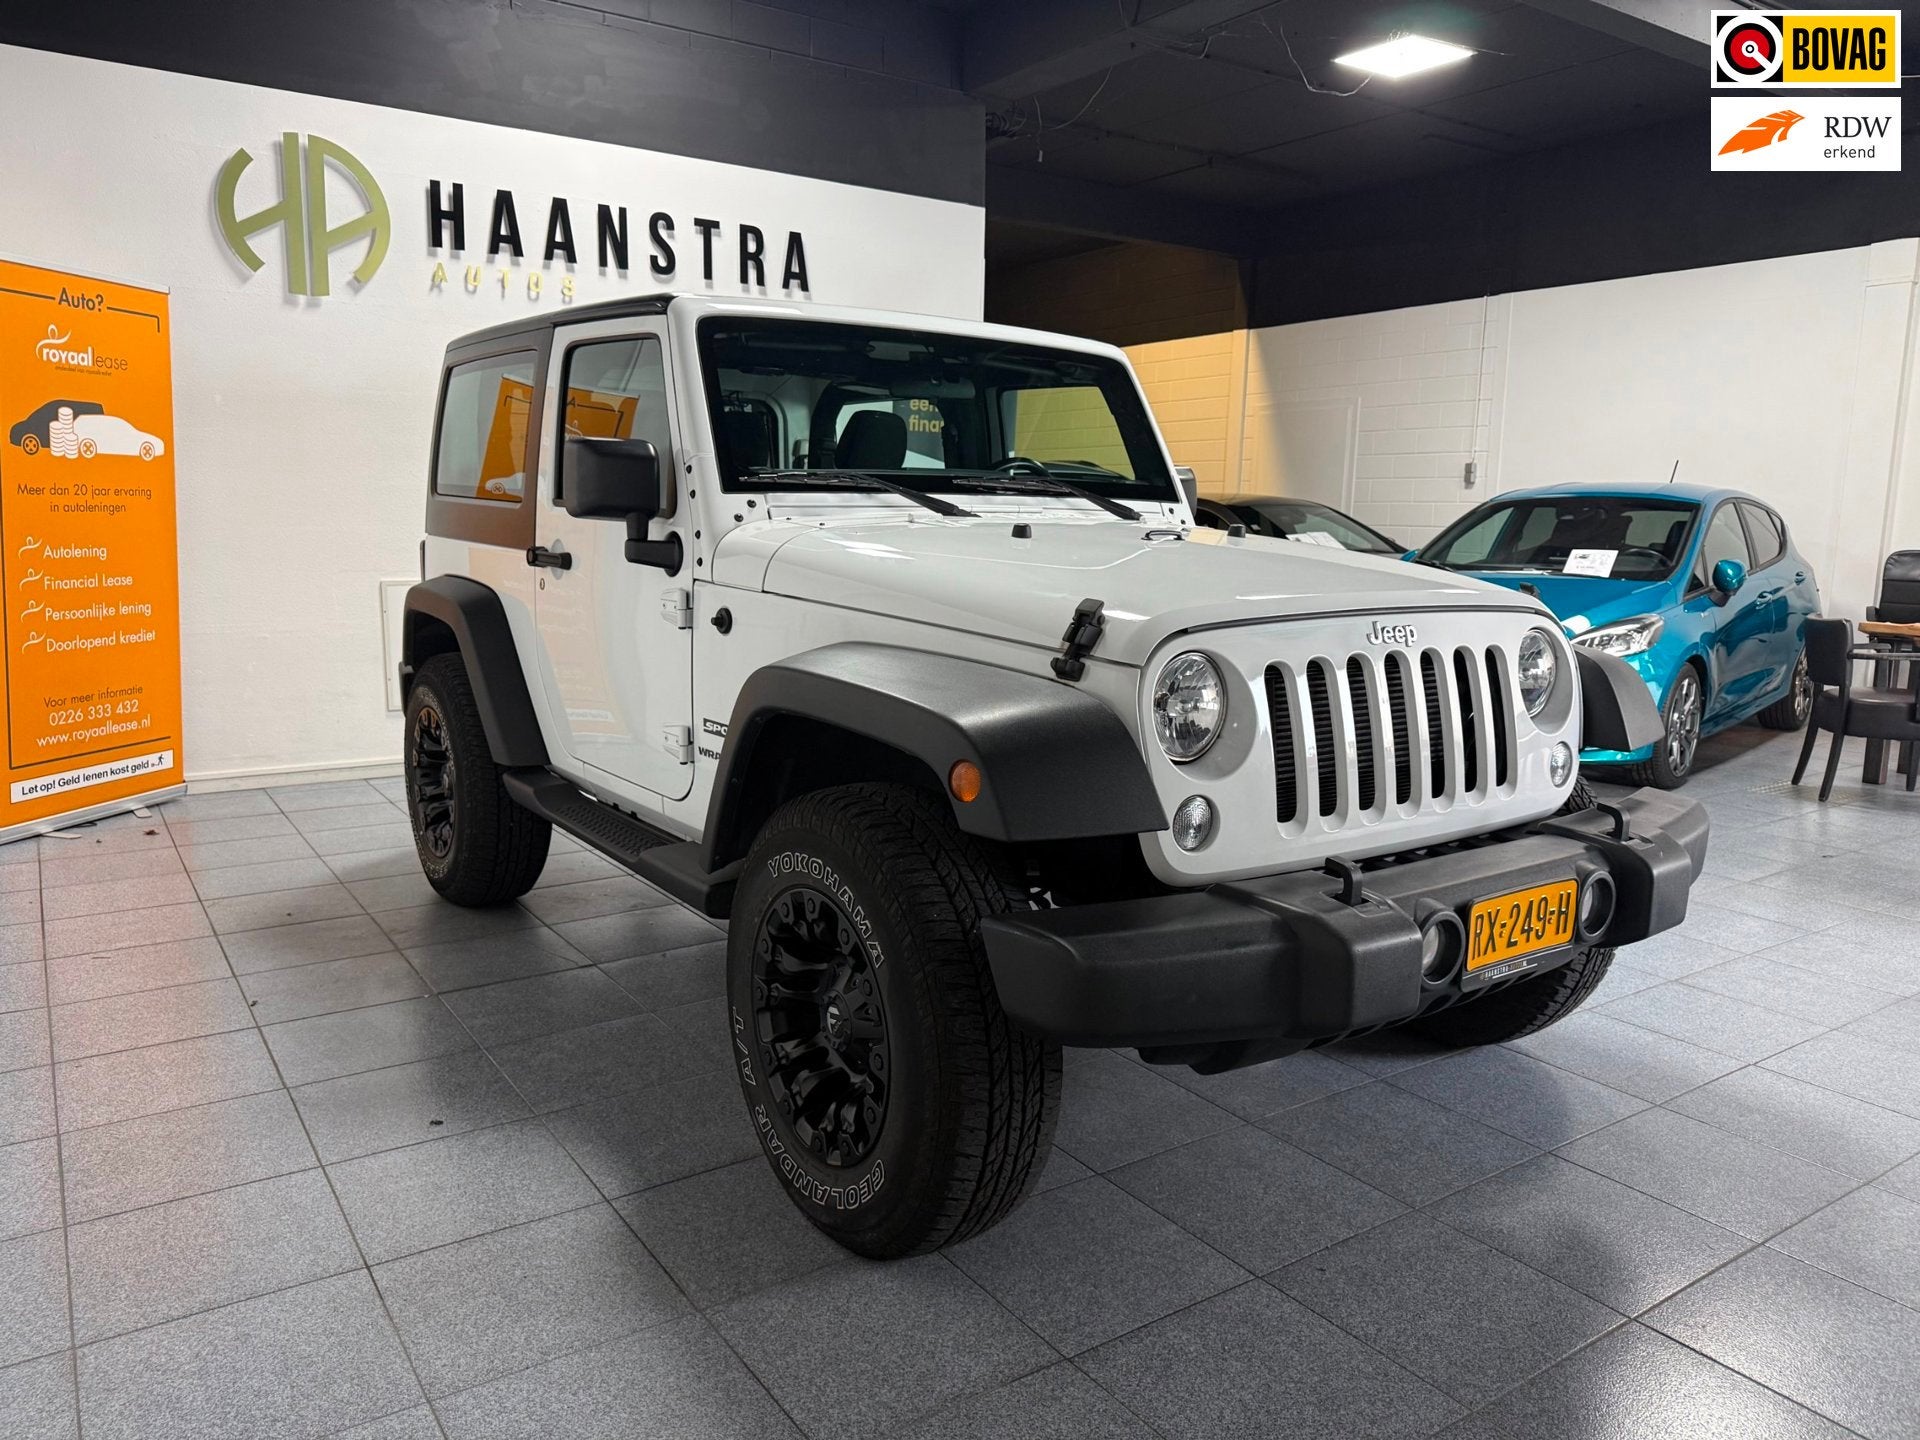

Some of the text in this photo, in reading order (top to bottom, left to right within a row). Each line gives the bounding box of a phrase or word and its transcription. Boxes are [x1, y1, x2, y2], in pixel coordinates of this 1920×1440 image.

[429, 179, 810, 293] HAANSTRA
[432, 262, 577, 297] AUTOS
[58, 287, 104, 312] Auto?
[17, 483, 152, 500] Meer dan 20 jaar ervaring
[50, 500, 127, 516] in autoleningen
[43, 544, 107, 561] Autolening
[44, 573, 133, 590] Financial Lease
[45, 601, 152, 622] Persoonlijke lening
[46, 629, 156, 653] Doorlopend krediet
[1366, 620, 1418, 647] Jeep
[43, 684, 143, 709] Voor meer informatie
[49, 699, 139, 727] 0226 333 432
[36, 714, 151, 748] www.royaallease.nl
[21, 760, 150, 796] Let op! Geld lenen kost geld
[767, 852, 885, 969] YOKOHAMA
[1471, 890, 1573, 961] RX-249-H
[754, 1103, 885, 1210] GEOLANDAR
